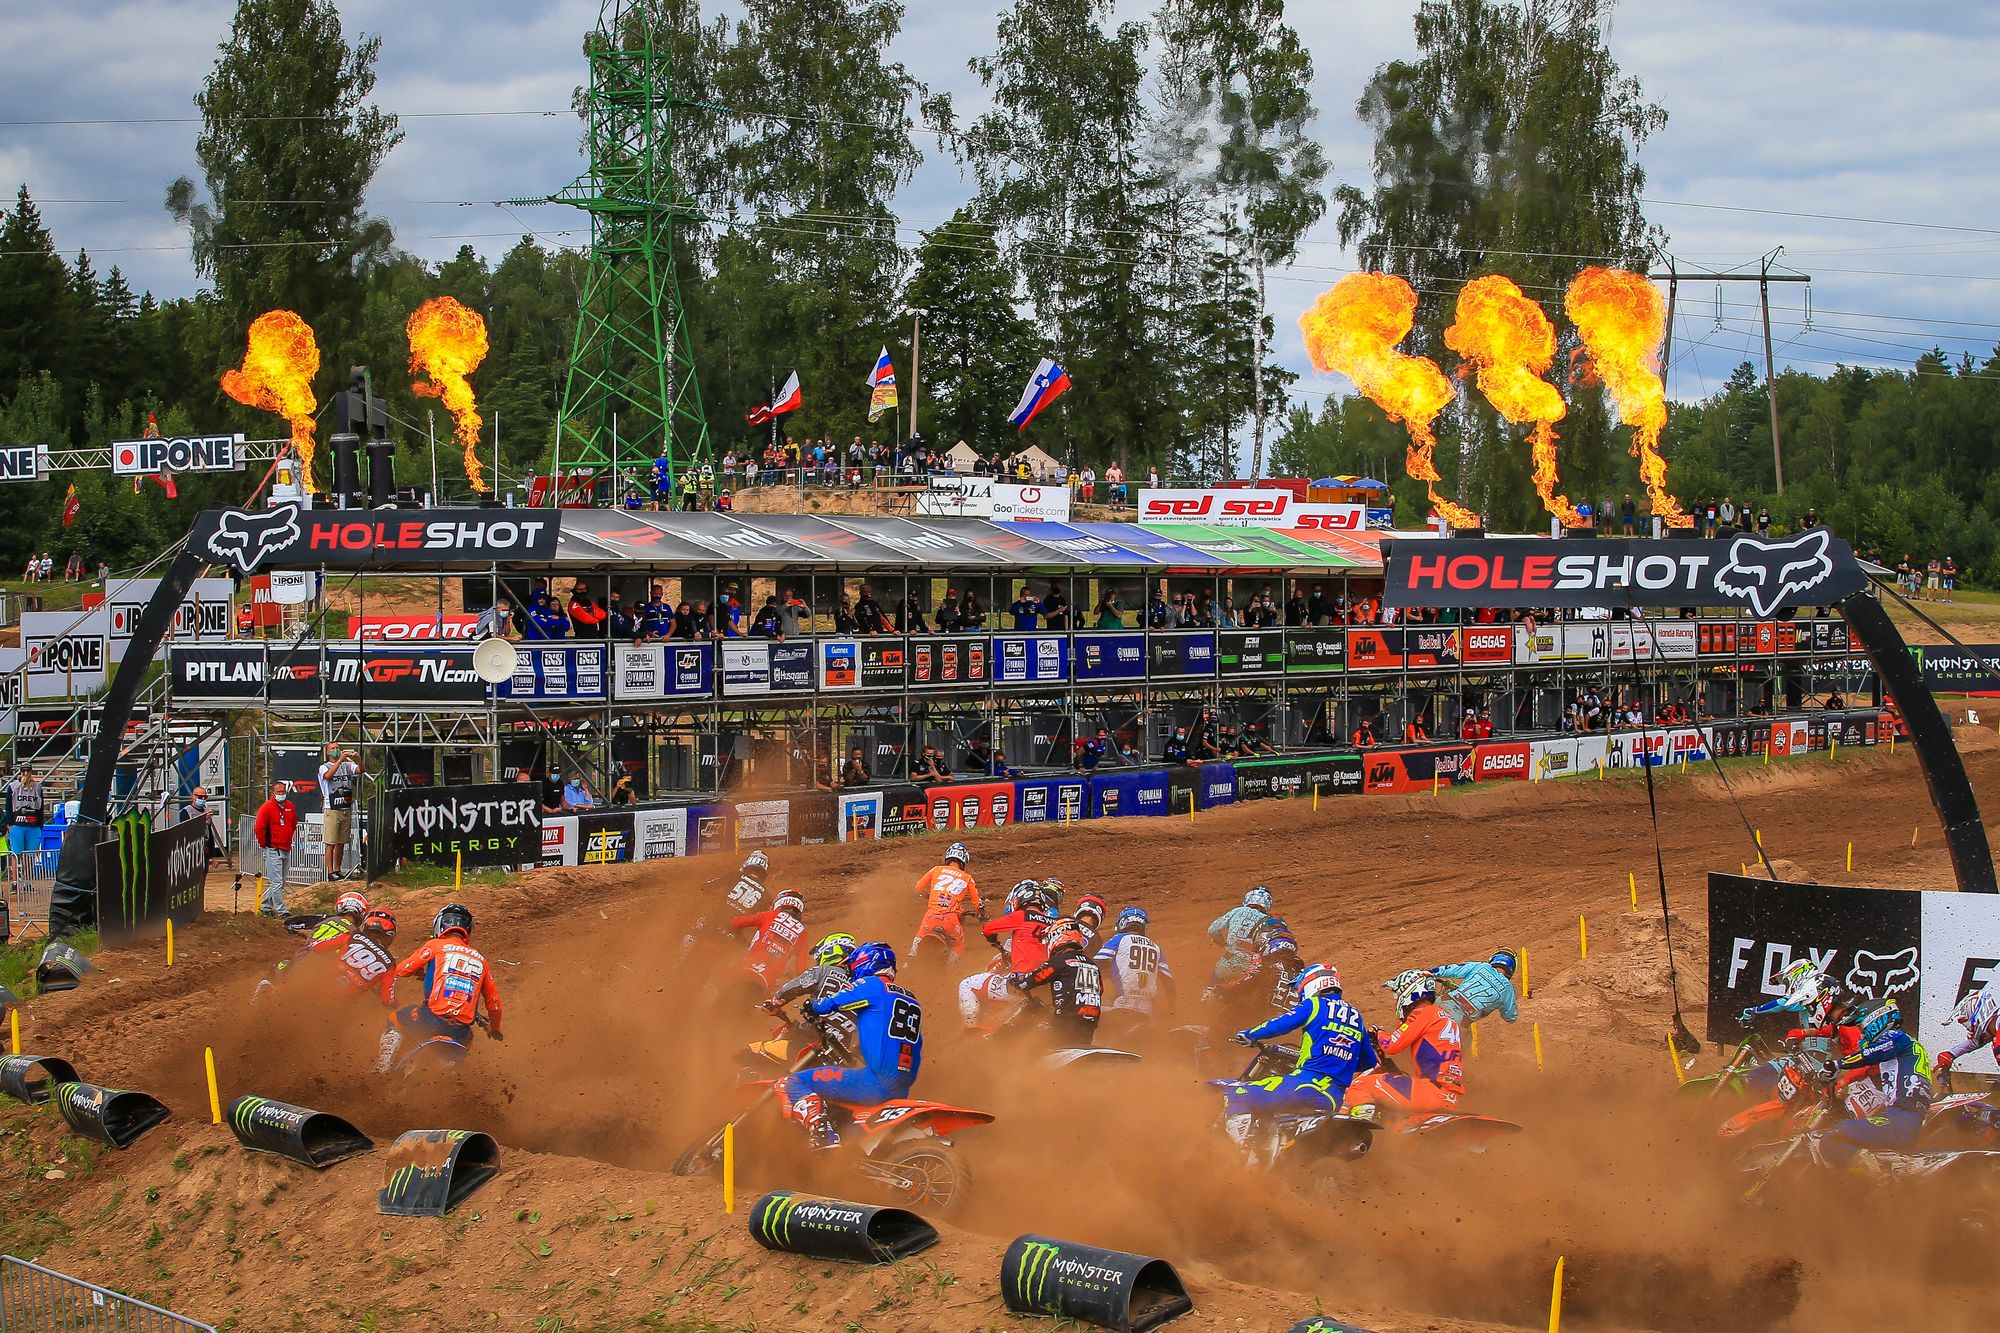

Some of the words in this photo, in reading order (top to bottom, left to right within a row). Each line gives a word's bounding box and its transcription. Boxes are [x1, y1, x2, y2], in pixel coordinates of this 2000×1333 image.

[140, 440, 231, 469] IPONE
[993, 503, 1066, 516] GooTickets.com
[1145, 495, 1213, 515] sel
[1221, 495, 1288, 515] sel
[1294, 510, 1360, 529] sel
[309, 521, 544, 549] HOLESHOT
[277, 576, 304, 585] IPONE
[1408, 555, 1709, 589] HOLESHOT
[1469, 635, 1506, 649] GASGAS
[1658, 629, 1675, 637] Honda
[1676, 629, 1693, 639] Racing
[1121, 647, 1140, 658] YAMAHA
[1193, 646, 1210, 657] YAMAHA
[1354, 637, 1377, 655] KTM
[1242, 653, 1262, 662] Kawasaki
[186, 662, 269, 681] PITLAN
[632, 671, 653, 683] YAMAHA
[1483, 752, 1525, 770] GASGAS
[1369, 762, 1395, 784] KTM
[1143, 788, 1162, 800] YAMAHA
[1213, 783, 1232, 795] YAMAHA
[394, 797, 541, 837] MONSTER
[414, 836, 518, 855] ENERGY
[651, 842, 675, 854] YAMAHA
[727, 881, 763, 908] 516
[933, 874, 968, 896] 28
[340, 942, 388, 981] 199
[442, 951, 485, 979] 102
[1129, 945, 1159, 973] 919
[1327, 1002, 1360, 1028] 142
[257, 1104, 303, 1125] MONSTER
[258, 1117, 290, 1130] ENERGY
[795, 1205, 864, 1225] MONSTER
[801, 1220, 849, 1233] ENERGY
[1052, 1256, 1123, 1286] MONSTER
[1058, 1276, 1110, 1293] ENERGY
